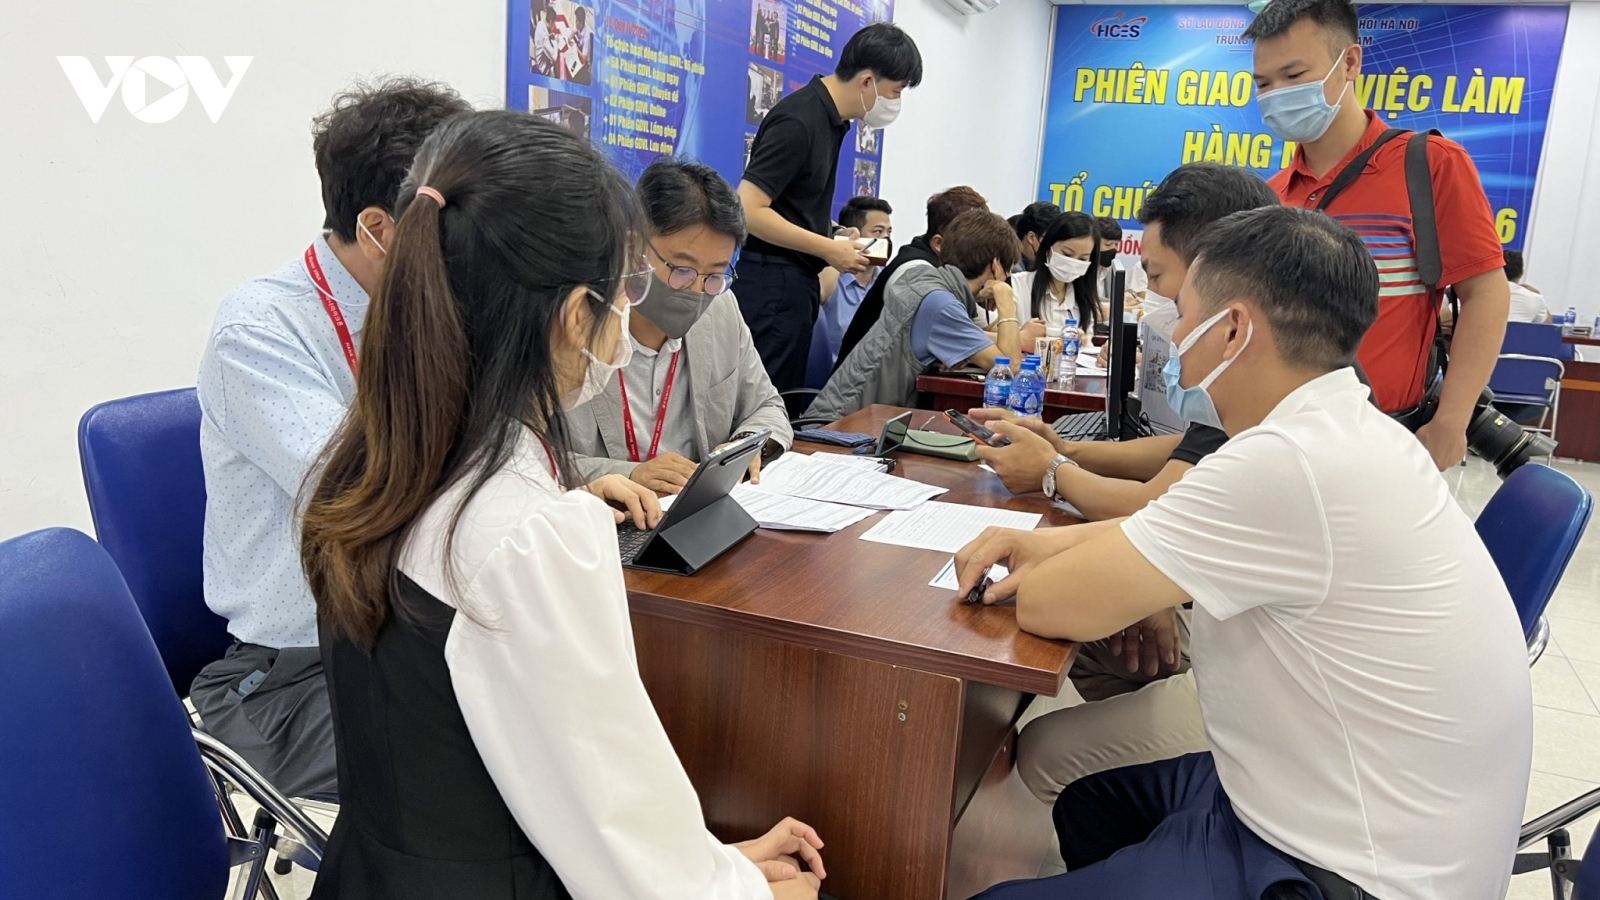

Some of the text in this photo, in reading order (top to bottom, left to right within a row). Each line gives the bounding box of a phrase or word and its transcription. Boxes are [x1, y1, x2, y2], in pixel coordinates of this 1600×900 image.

[1097, 24, 1140, 38] HCES
[1358, 17, 1419, 32] HỘI HÀ NỘI
[1073, 61, 1253, 107] PHIÊN GIAO
[1354, 66, 1525, 119] VIỆC LÀM
[1182, 122, 1273, 169] HÀNG
[1049, 170, 1159, 220] TỔ CHỨ
